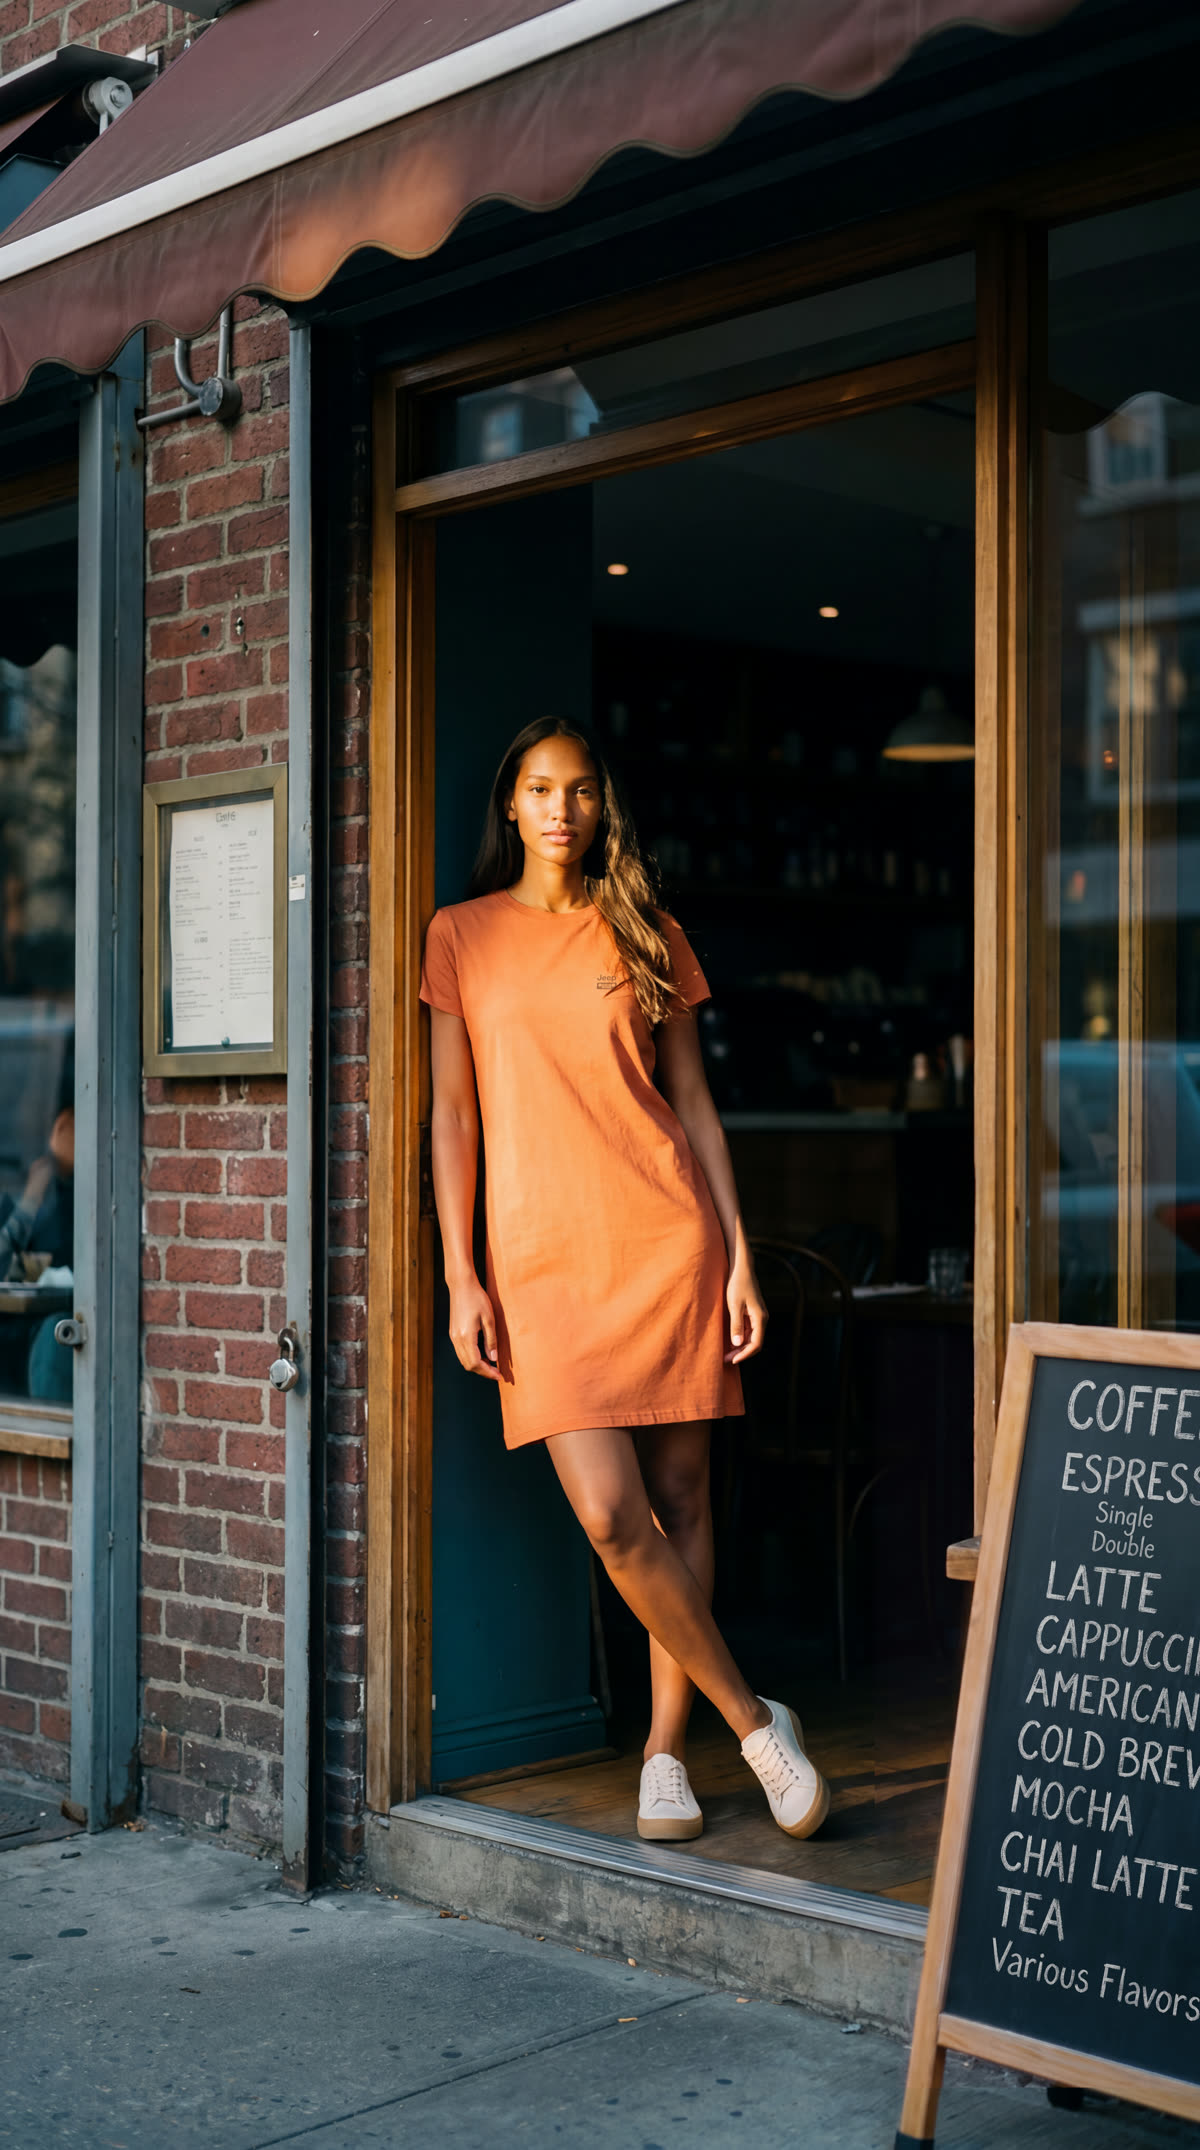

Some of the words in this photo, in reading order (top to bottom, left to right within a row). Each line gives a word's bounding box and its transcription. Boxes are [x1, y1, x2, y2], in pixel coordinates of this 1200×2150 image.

[597, 974, 616, 982] Jeep
[1067, 1379, 1200, 1440] COFFE
[1092, 1530, 1155, 1558] Double
[1096, 1501, 1153, 1536] Single
[1046, 1560, 1162, 1614] LATTE
[1036, 1615, 1200, 1677] CAPPUCCI
[1025, 1668, 1200, 1732] AMERICAN
[1018, 1720, 1106, 1771] COLD
[1011, 1774, 1134, 1837] MOCHA
[1000, 1831, 1077, 1884] CHAI
[1091, 1849, 1198, 1910] LATTE
[997, 1885, 1064, 1941] TEA
[992, 1937, 1089, 1993] Various
[1100, 1963, 1200, 2021] Flavors
